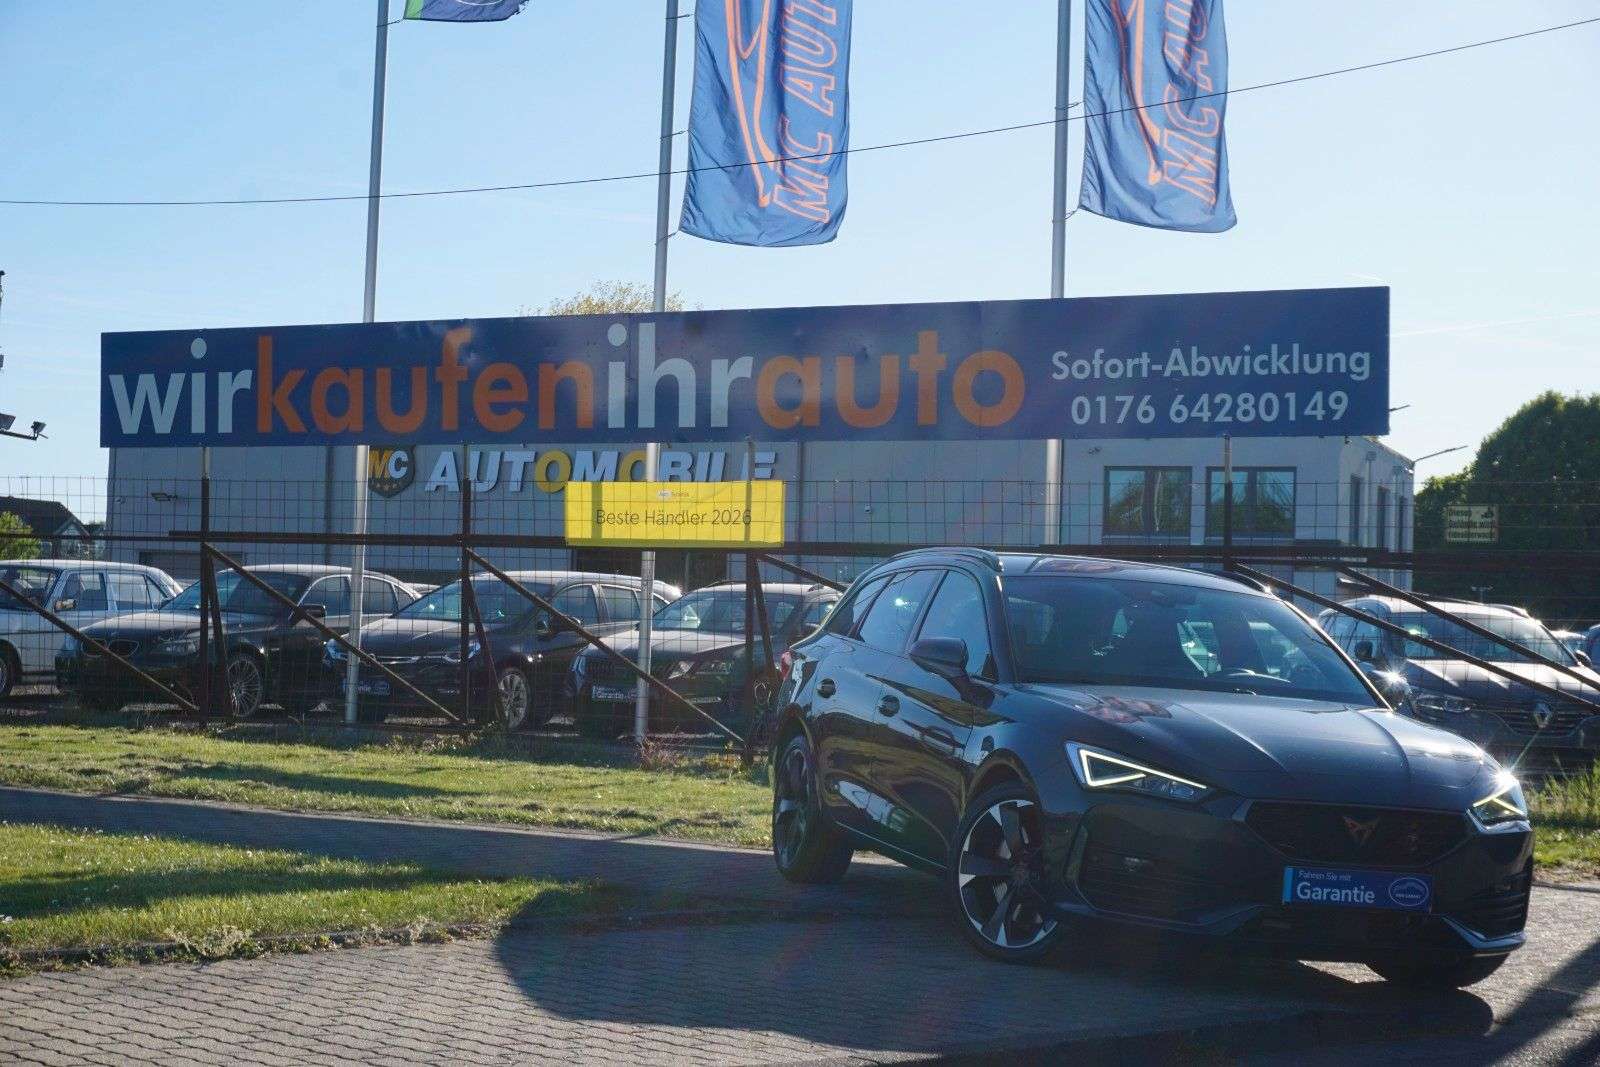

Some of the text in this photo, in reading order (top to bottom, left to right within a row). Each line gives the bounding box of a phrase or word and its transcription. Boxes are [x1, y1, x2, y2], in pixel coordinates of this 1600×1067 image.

[1162, 82, 1220, 207] MC
[774, 113, 833, 224] MC
[1052, 344, 1370, 381] Sofort-Abwicklung
[1071, 390, 1349, 425] 0176 64280149
[596, 509, 640, 526] Beste
[645, 509, 707, 526] Händler
[1296, 881, 1376, 904] Garantie
